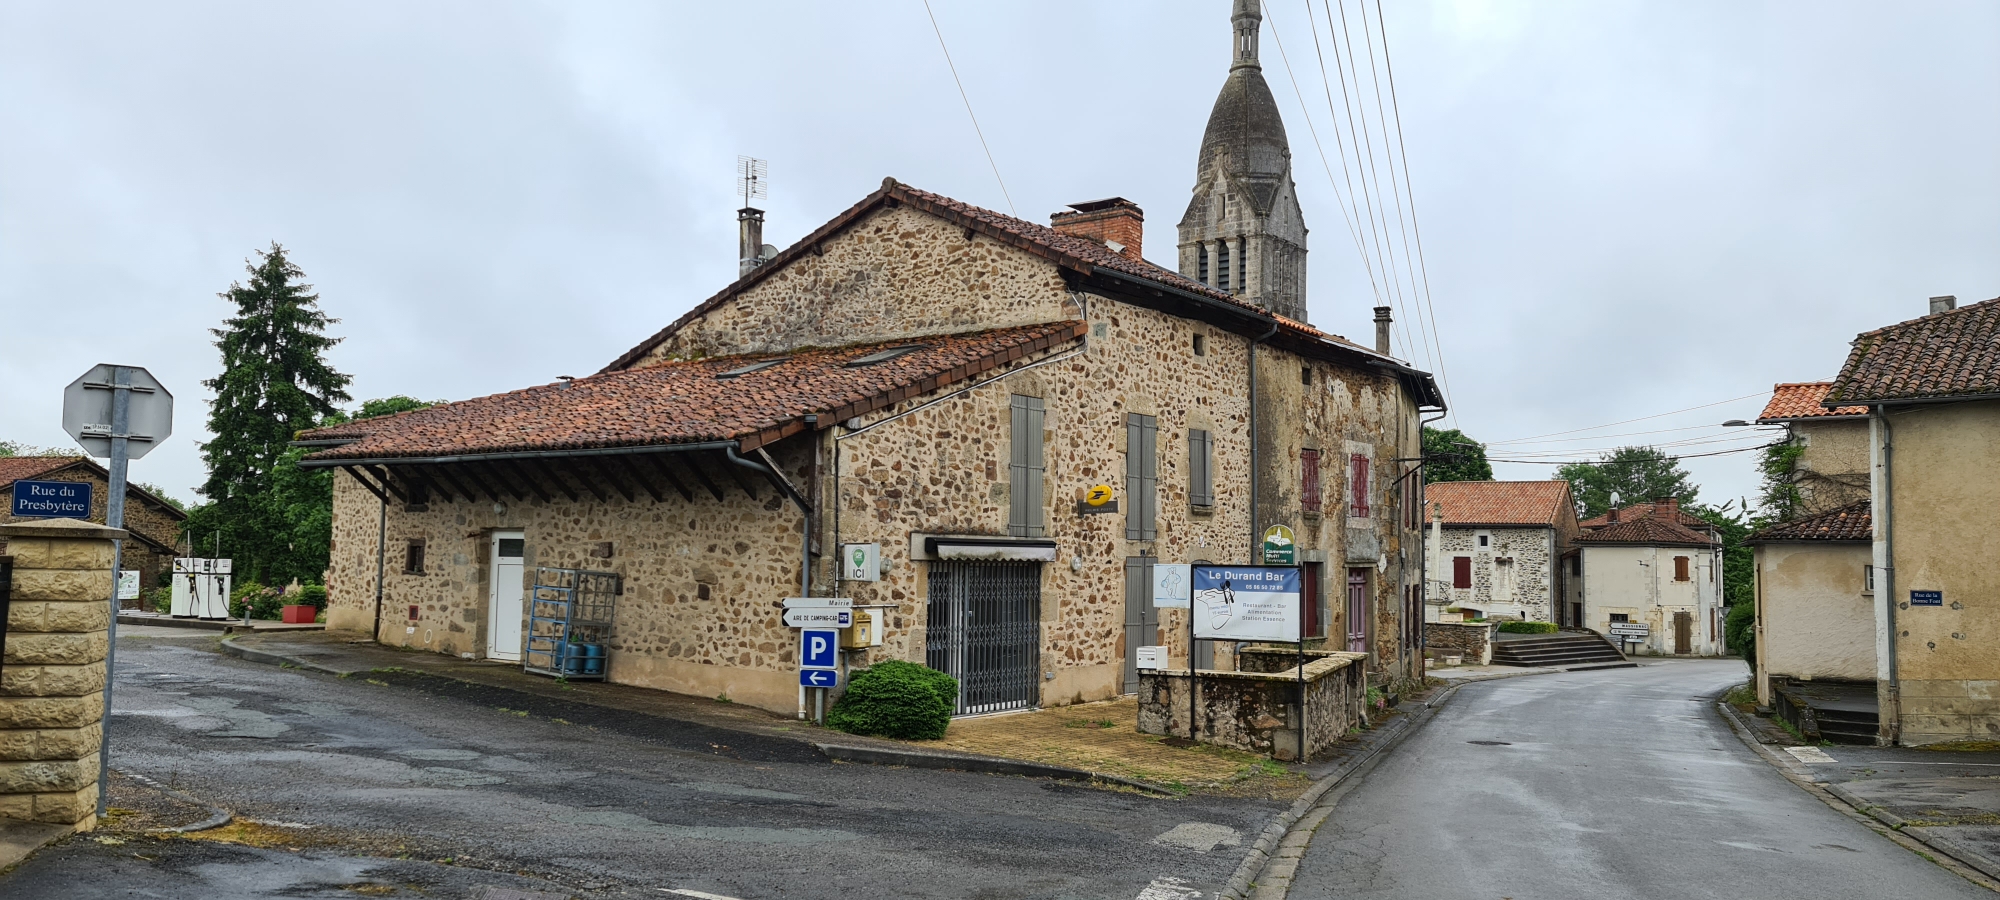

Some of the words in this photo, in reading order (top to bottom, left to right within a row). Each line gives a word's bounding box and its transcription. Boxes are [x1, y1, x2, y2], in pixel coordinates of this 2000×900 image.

[31, 485, 56, 496] Rue
[60, 486, 75, 497] du
[19, 499, 85, 513] Presbytère
[853, 569, 865, 578] ICI
[1209, 570, 1221, 580] Le
[1225, 571, 1262, 581] Durand
[1266, 572, 1285, 581] Bar
[811, 636, 827, 660] P
